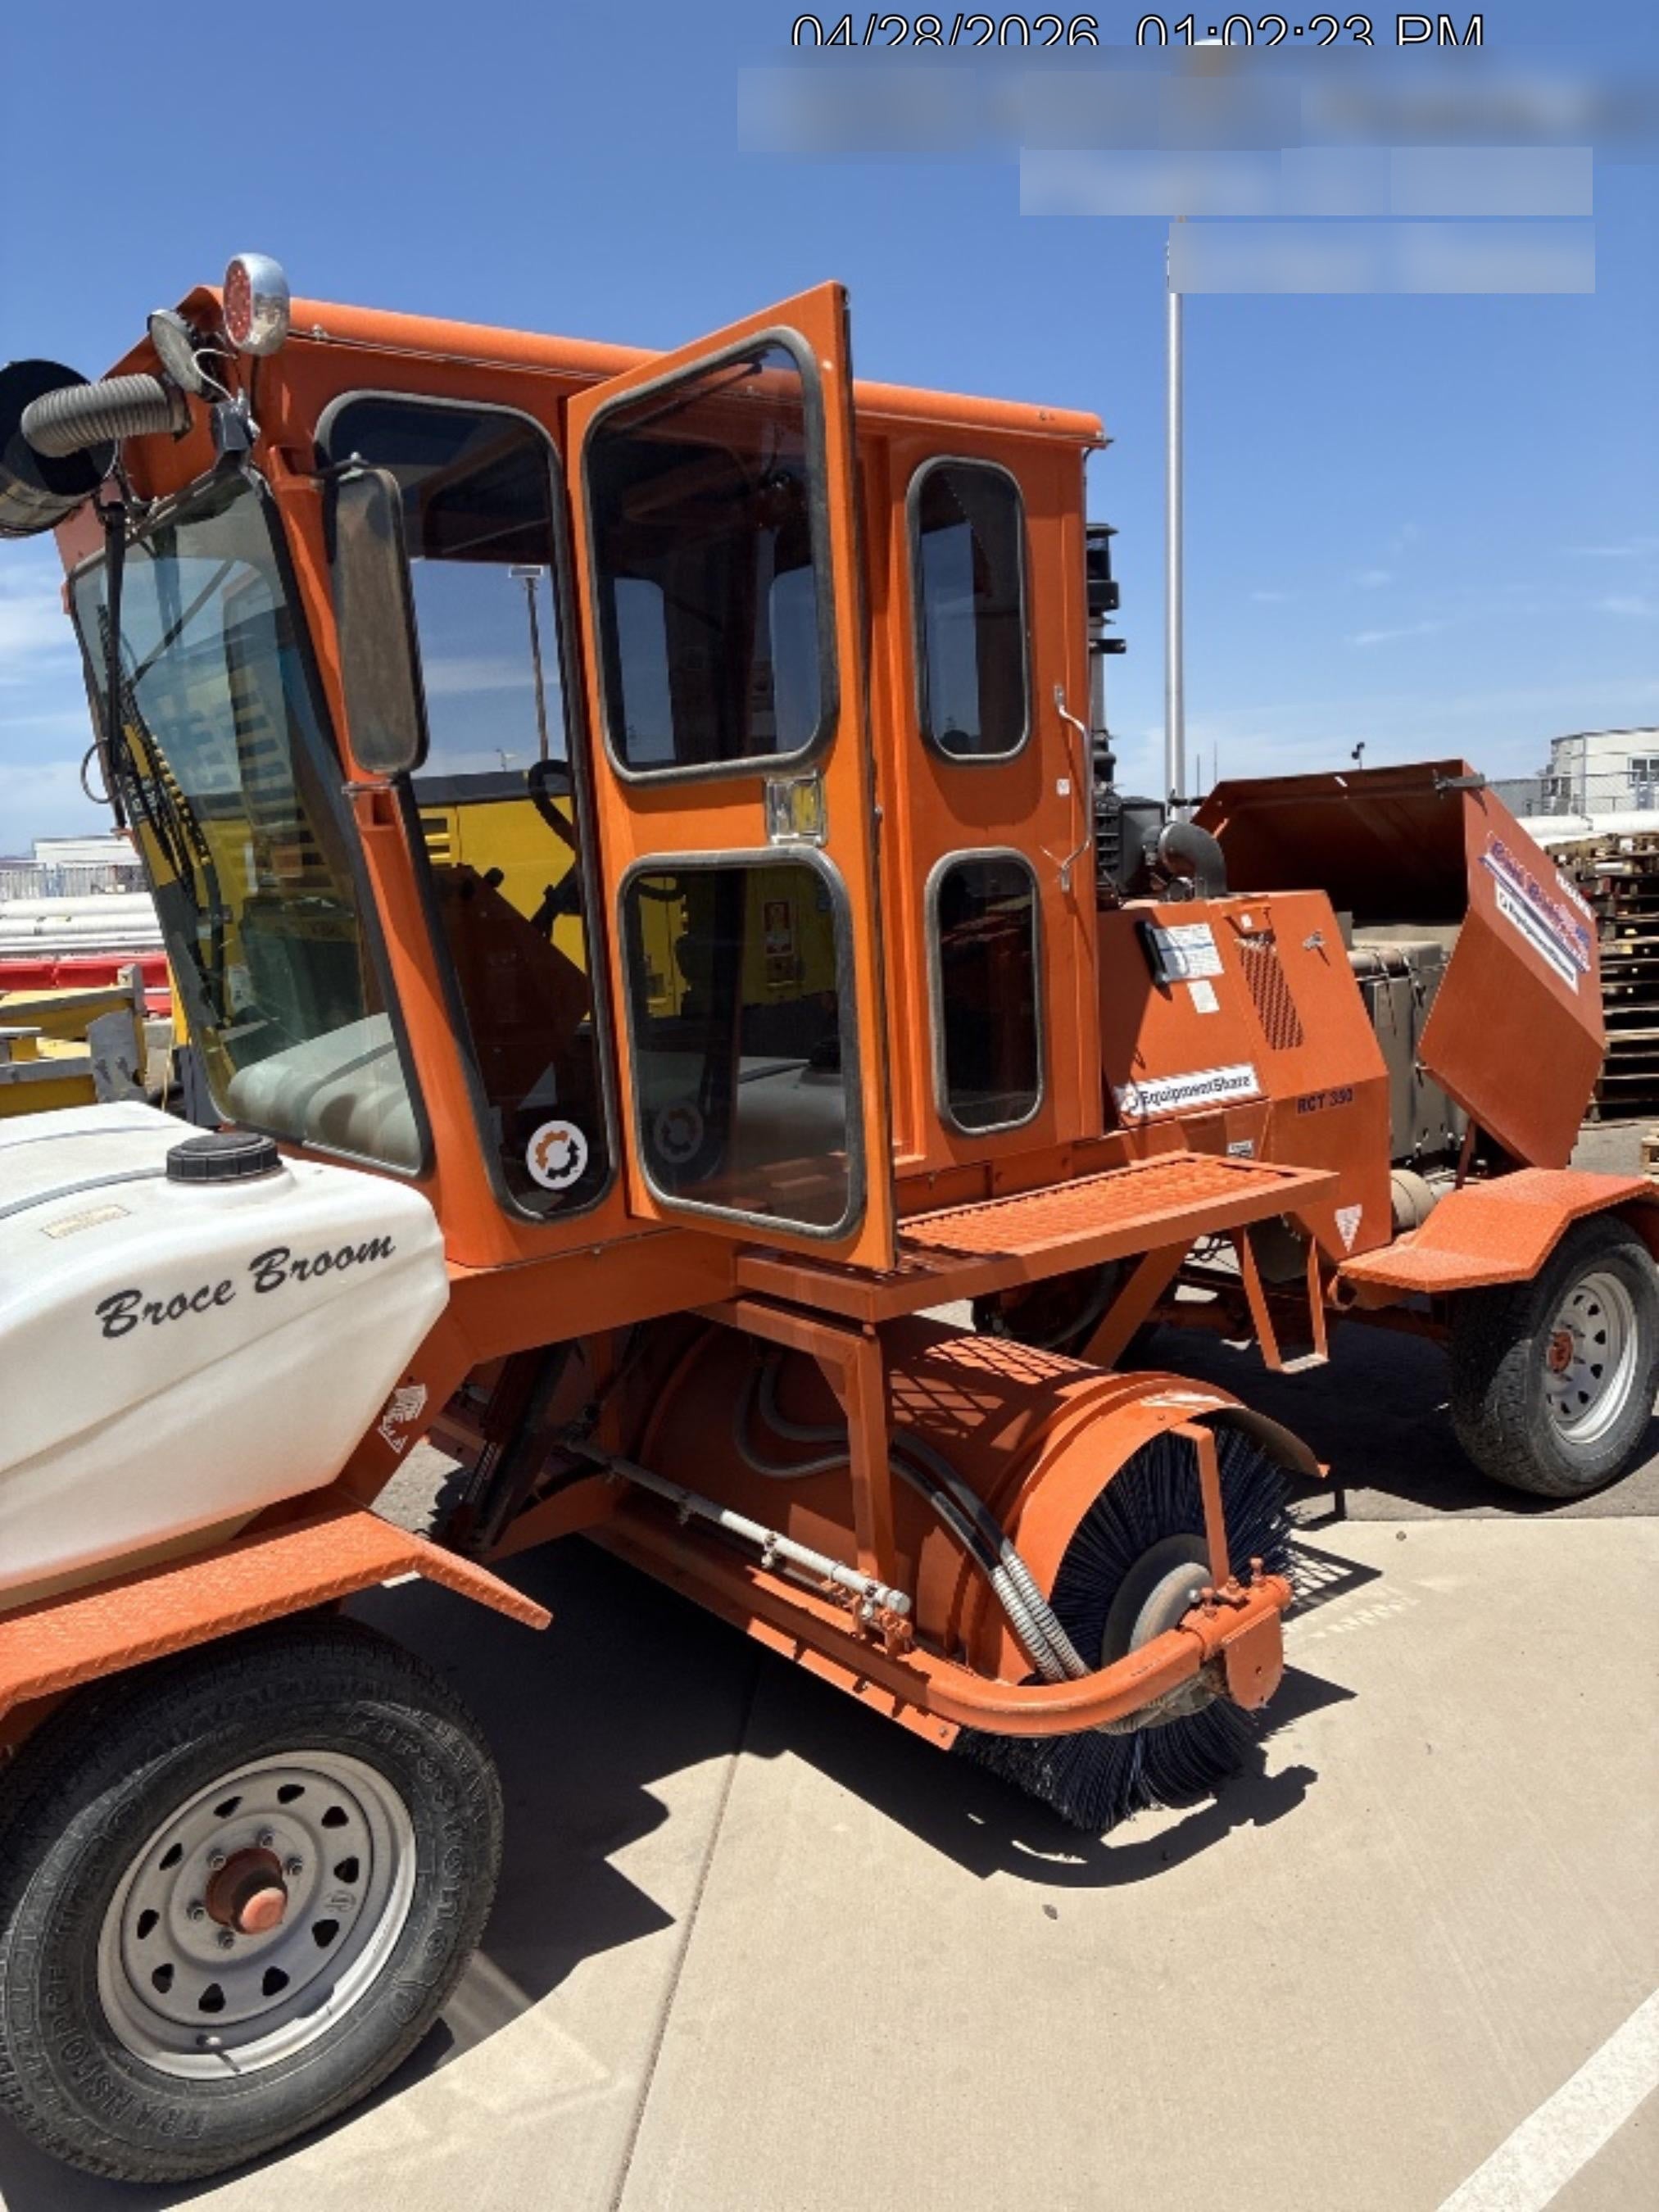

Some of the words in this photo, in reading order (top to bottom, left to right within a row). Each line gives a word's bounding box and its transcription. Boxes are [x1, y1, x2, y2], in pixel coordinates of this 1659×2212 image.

[1140, 1075, 1251, 1107] EquipmentShare
[1297, 1093, 1326, 1114] RCT
[95, 1280, 236, 1339] Broce
[247, 1235, 396, 1294] Broom
